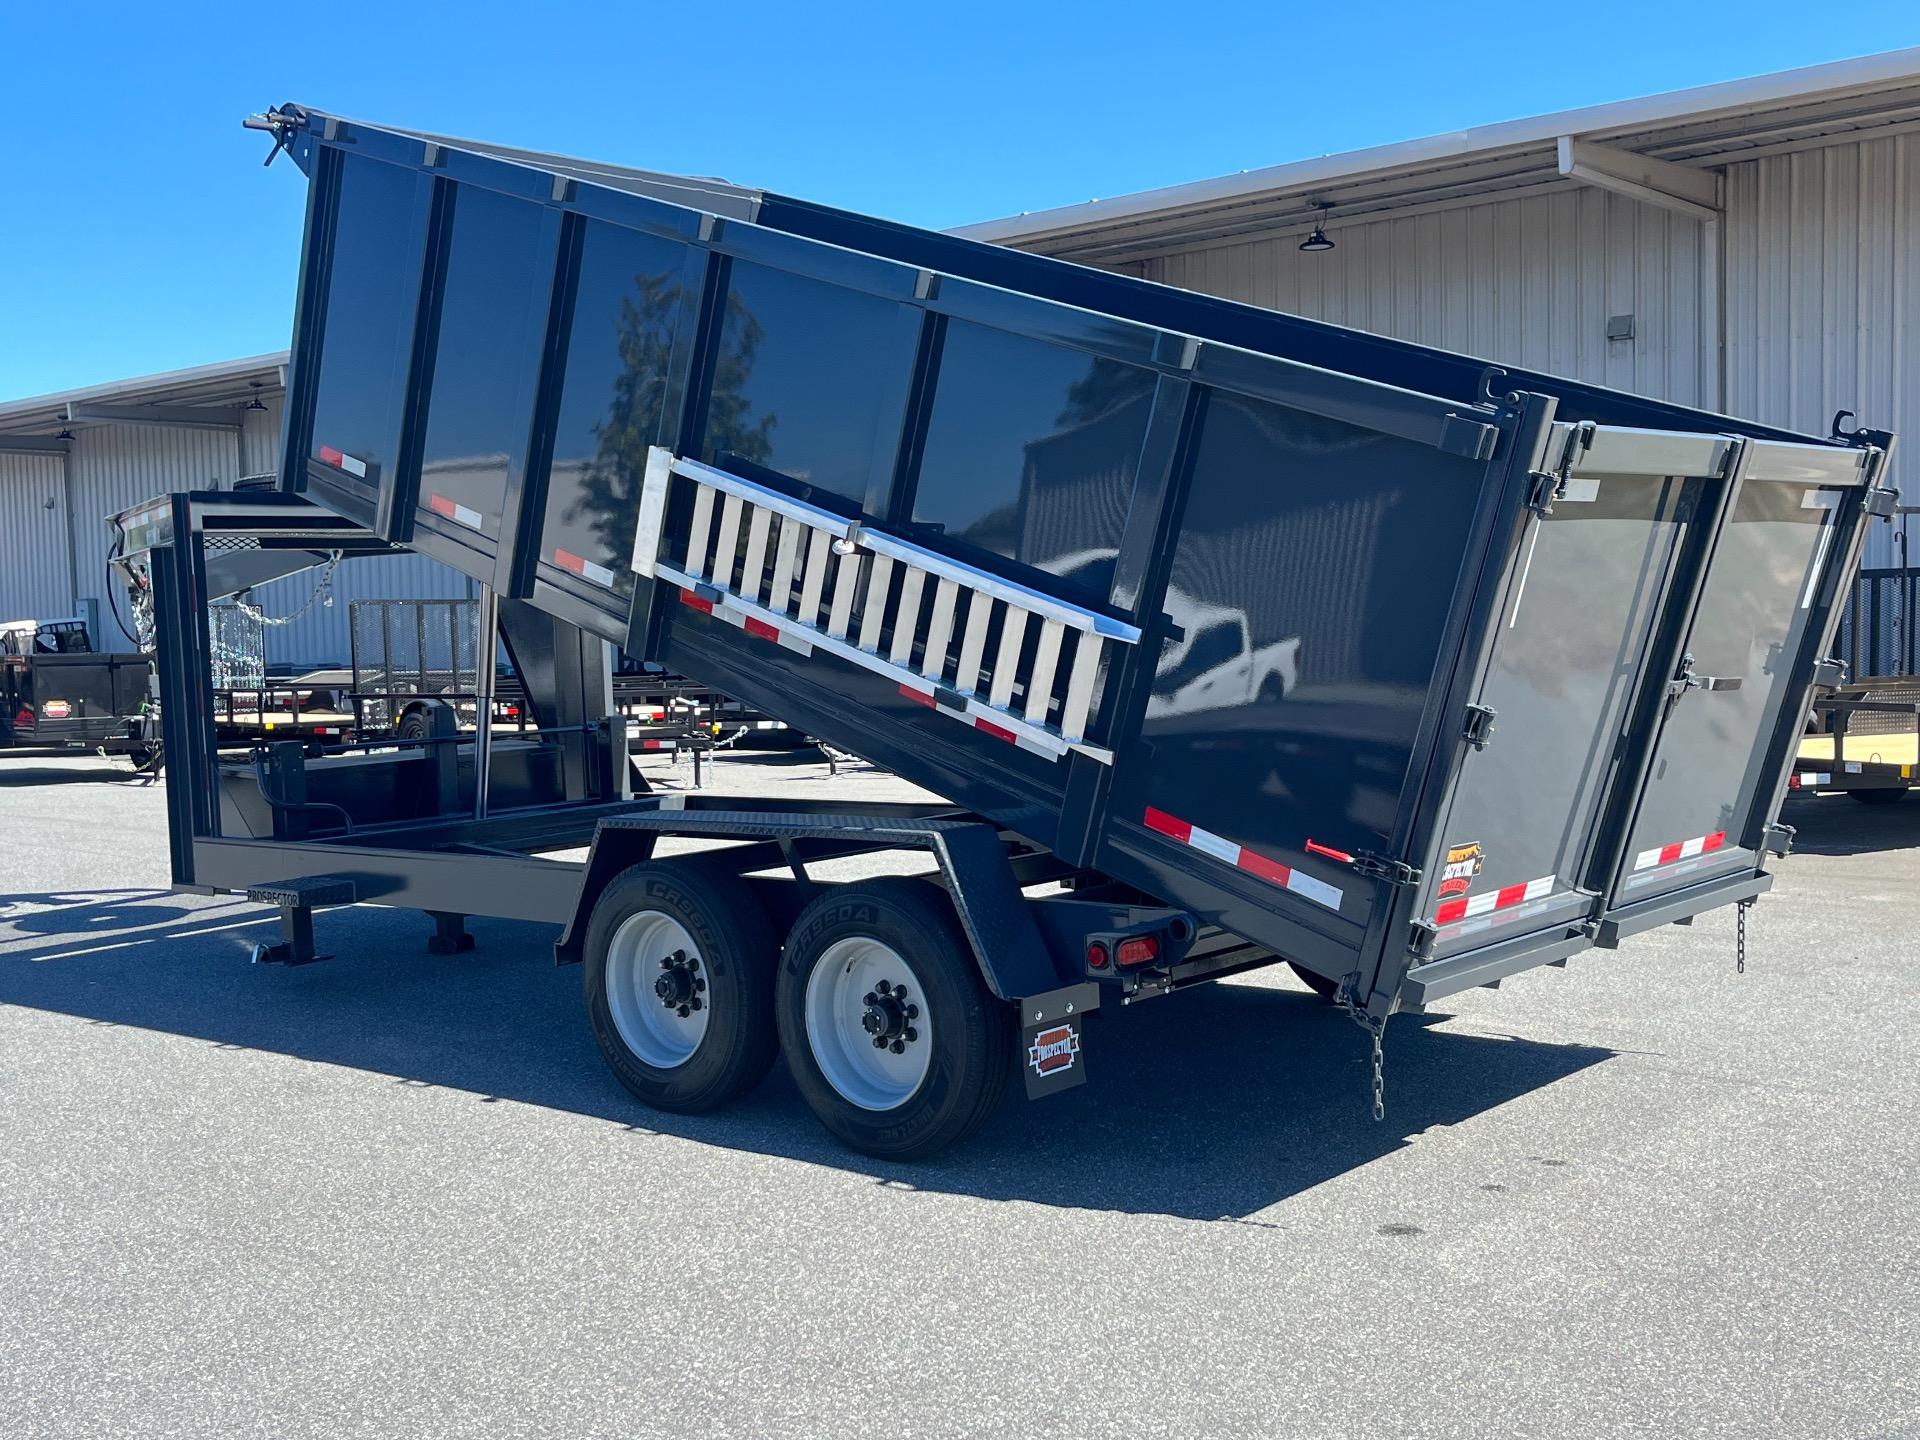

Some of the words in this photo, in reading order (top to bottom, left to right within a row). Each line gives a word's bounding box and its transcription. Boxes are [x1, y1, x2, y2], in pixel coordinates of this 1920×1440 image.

[1441, 857, 1476, 881] OSPECTOR
[247, 889, 298, 907] PROSPECTOR
[652, 881, 722, 968] CR960A
[791, 905, 870, 968] CR960A
